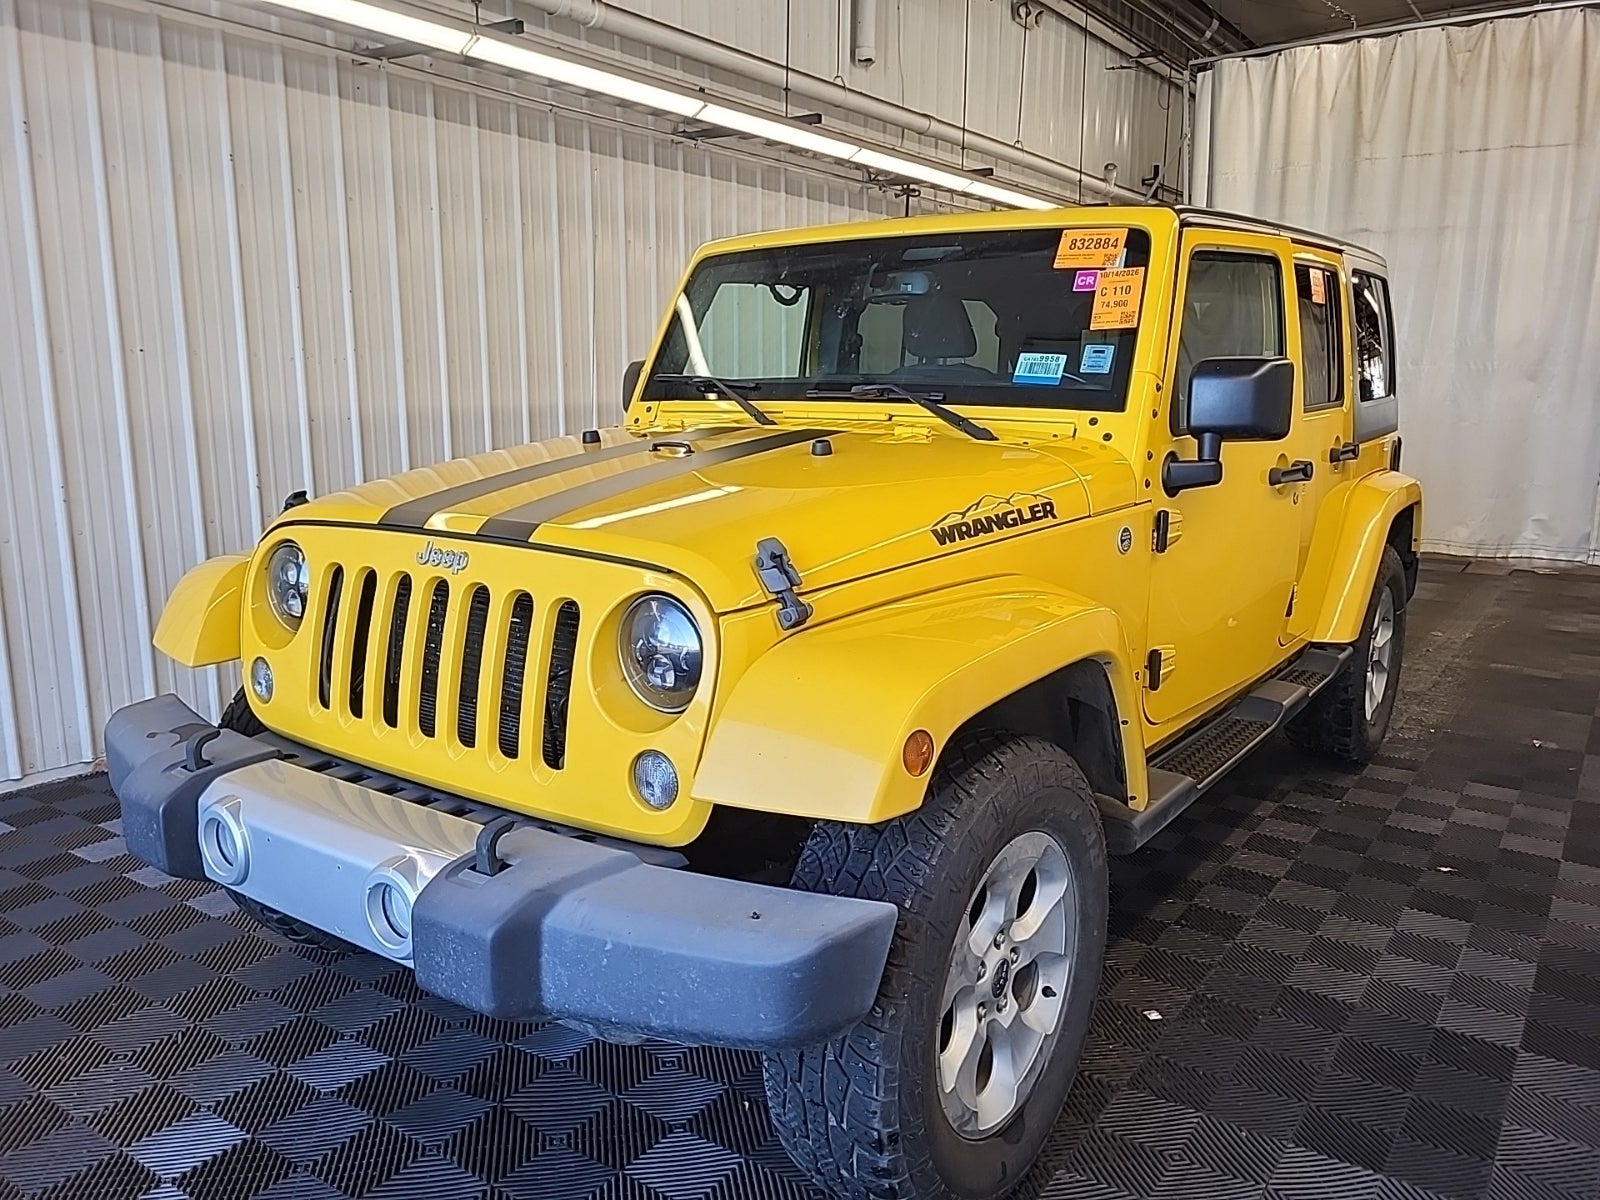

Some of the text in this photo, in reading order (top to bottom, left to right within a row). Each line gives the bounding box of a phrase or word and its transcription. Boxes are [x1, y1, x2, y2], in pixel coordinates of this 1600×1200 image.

[1069, 237, 1119, 250] 832884
[1100, 269, 1139, 279] 10/14/2026
[1077, 276, 1095, 286] CR
[1100, 285, 1131, 297] C 110
[1101, 300, 1128, 309] 74,900
[930, 501, 1057, 546] WRANGLER
[416, 541, 469, 575] Jeep
